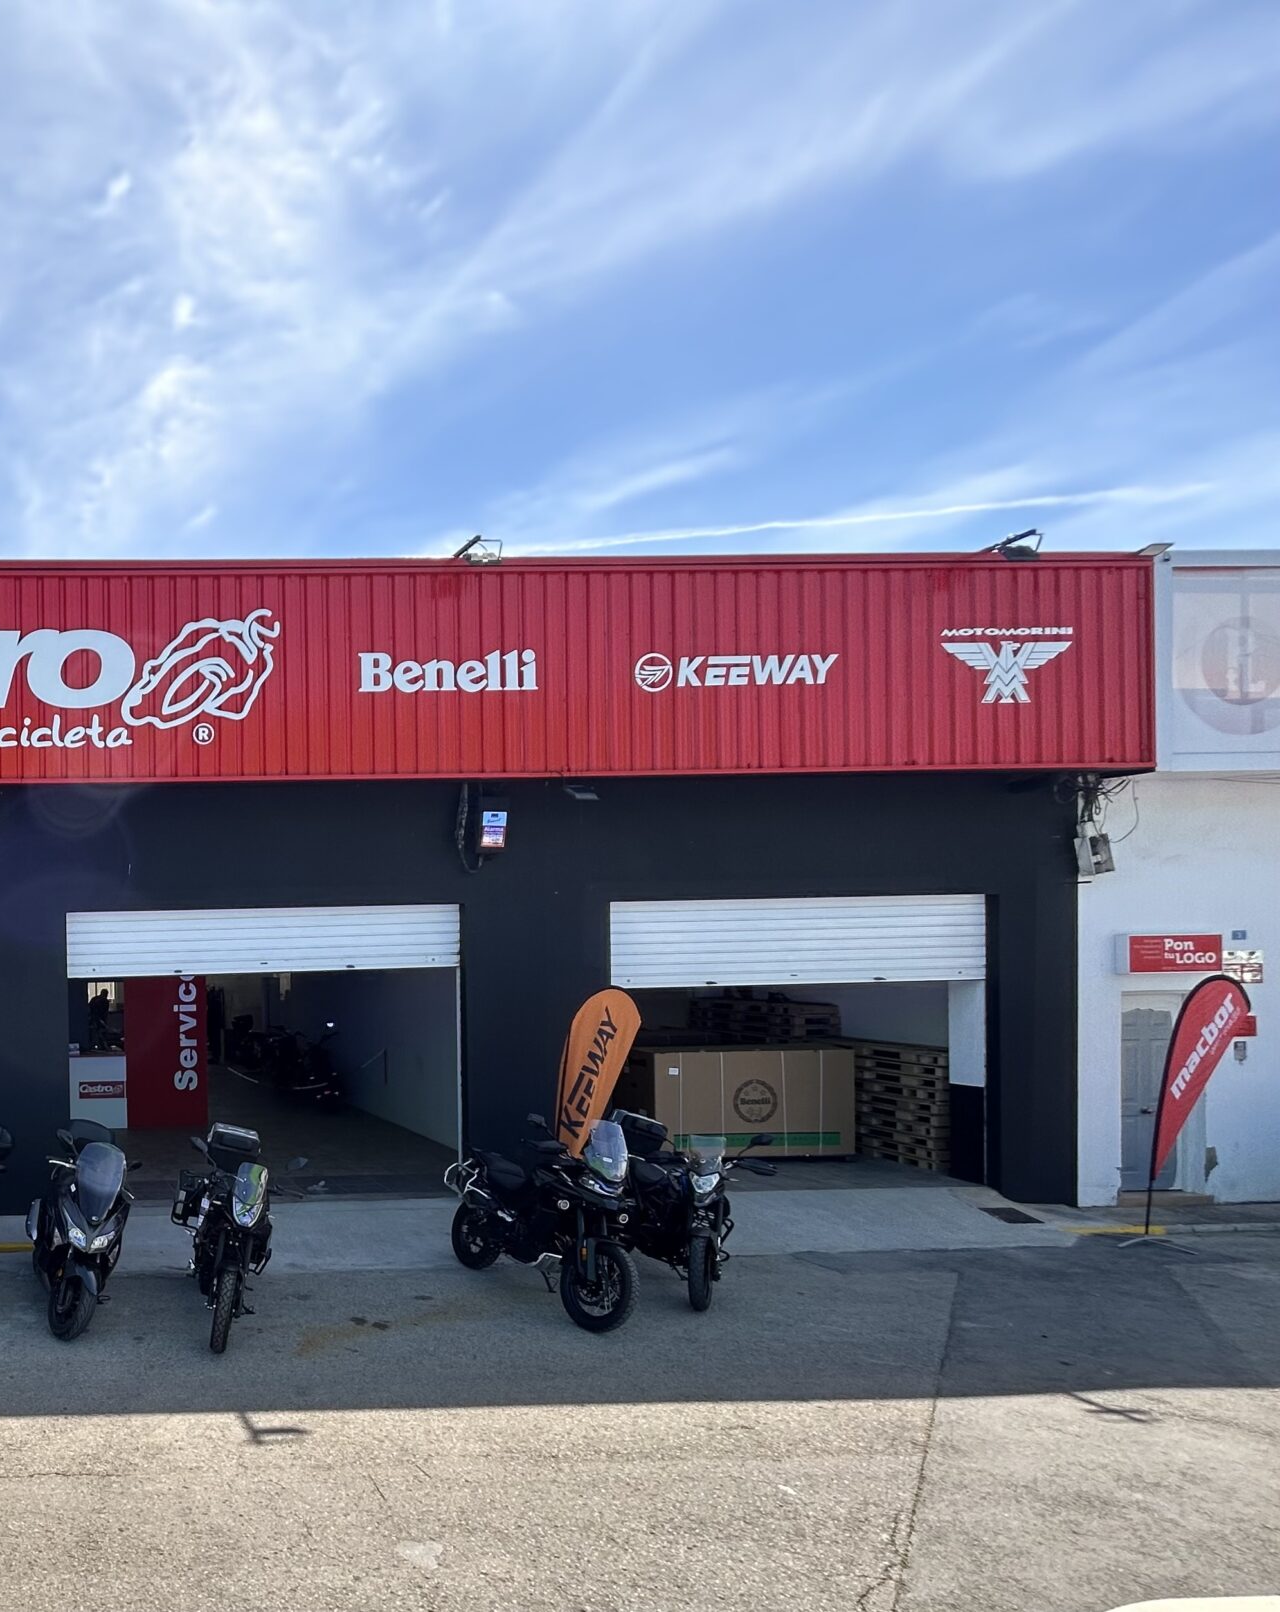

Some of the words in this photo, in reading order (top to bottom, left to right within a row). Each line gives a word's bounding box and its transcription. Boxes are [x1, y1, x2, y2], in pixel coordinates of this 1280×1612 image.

[357, 649, 538, 693] Benelli
[677, 653, 839, 688] KEEWAY
[1163, 939, 1195, 950] Pon
[1175, 952, 1217, 964] LOGO
[1170, 992, 1234, 1100] macbor
[560, 1005, 618, 1139] KEEWAY
[79, 1083, 113, 1094] Castro
[740, 1097, 771, 1105] Benelli
